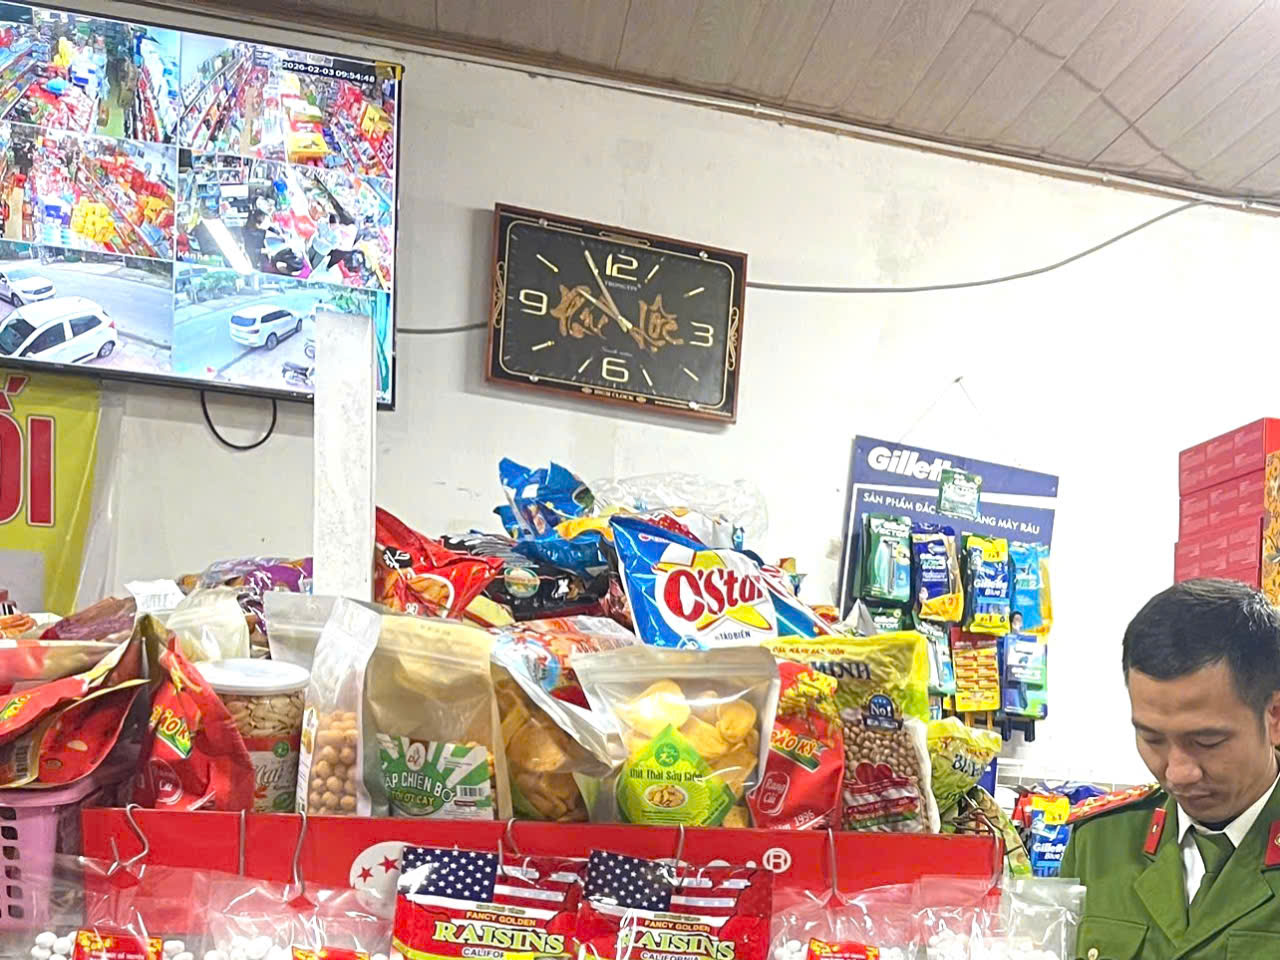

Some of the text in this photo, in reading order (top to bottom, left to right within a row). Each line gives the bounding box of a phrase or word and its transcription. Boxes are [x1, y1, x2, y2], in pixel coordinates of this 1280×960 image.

[605, 253, 638, 281] 12
[519, 288, 548, 316] 9
[689, 320, 714, 347] 3
[601, 356, 629, 383] 6
[466, 911, 537, 928] FANCY GOLDEN
[644, 919, 711, 933] FANCY GOLDEN
[432, 920, 565, 955] RAISINS
